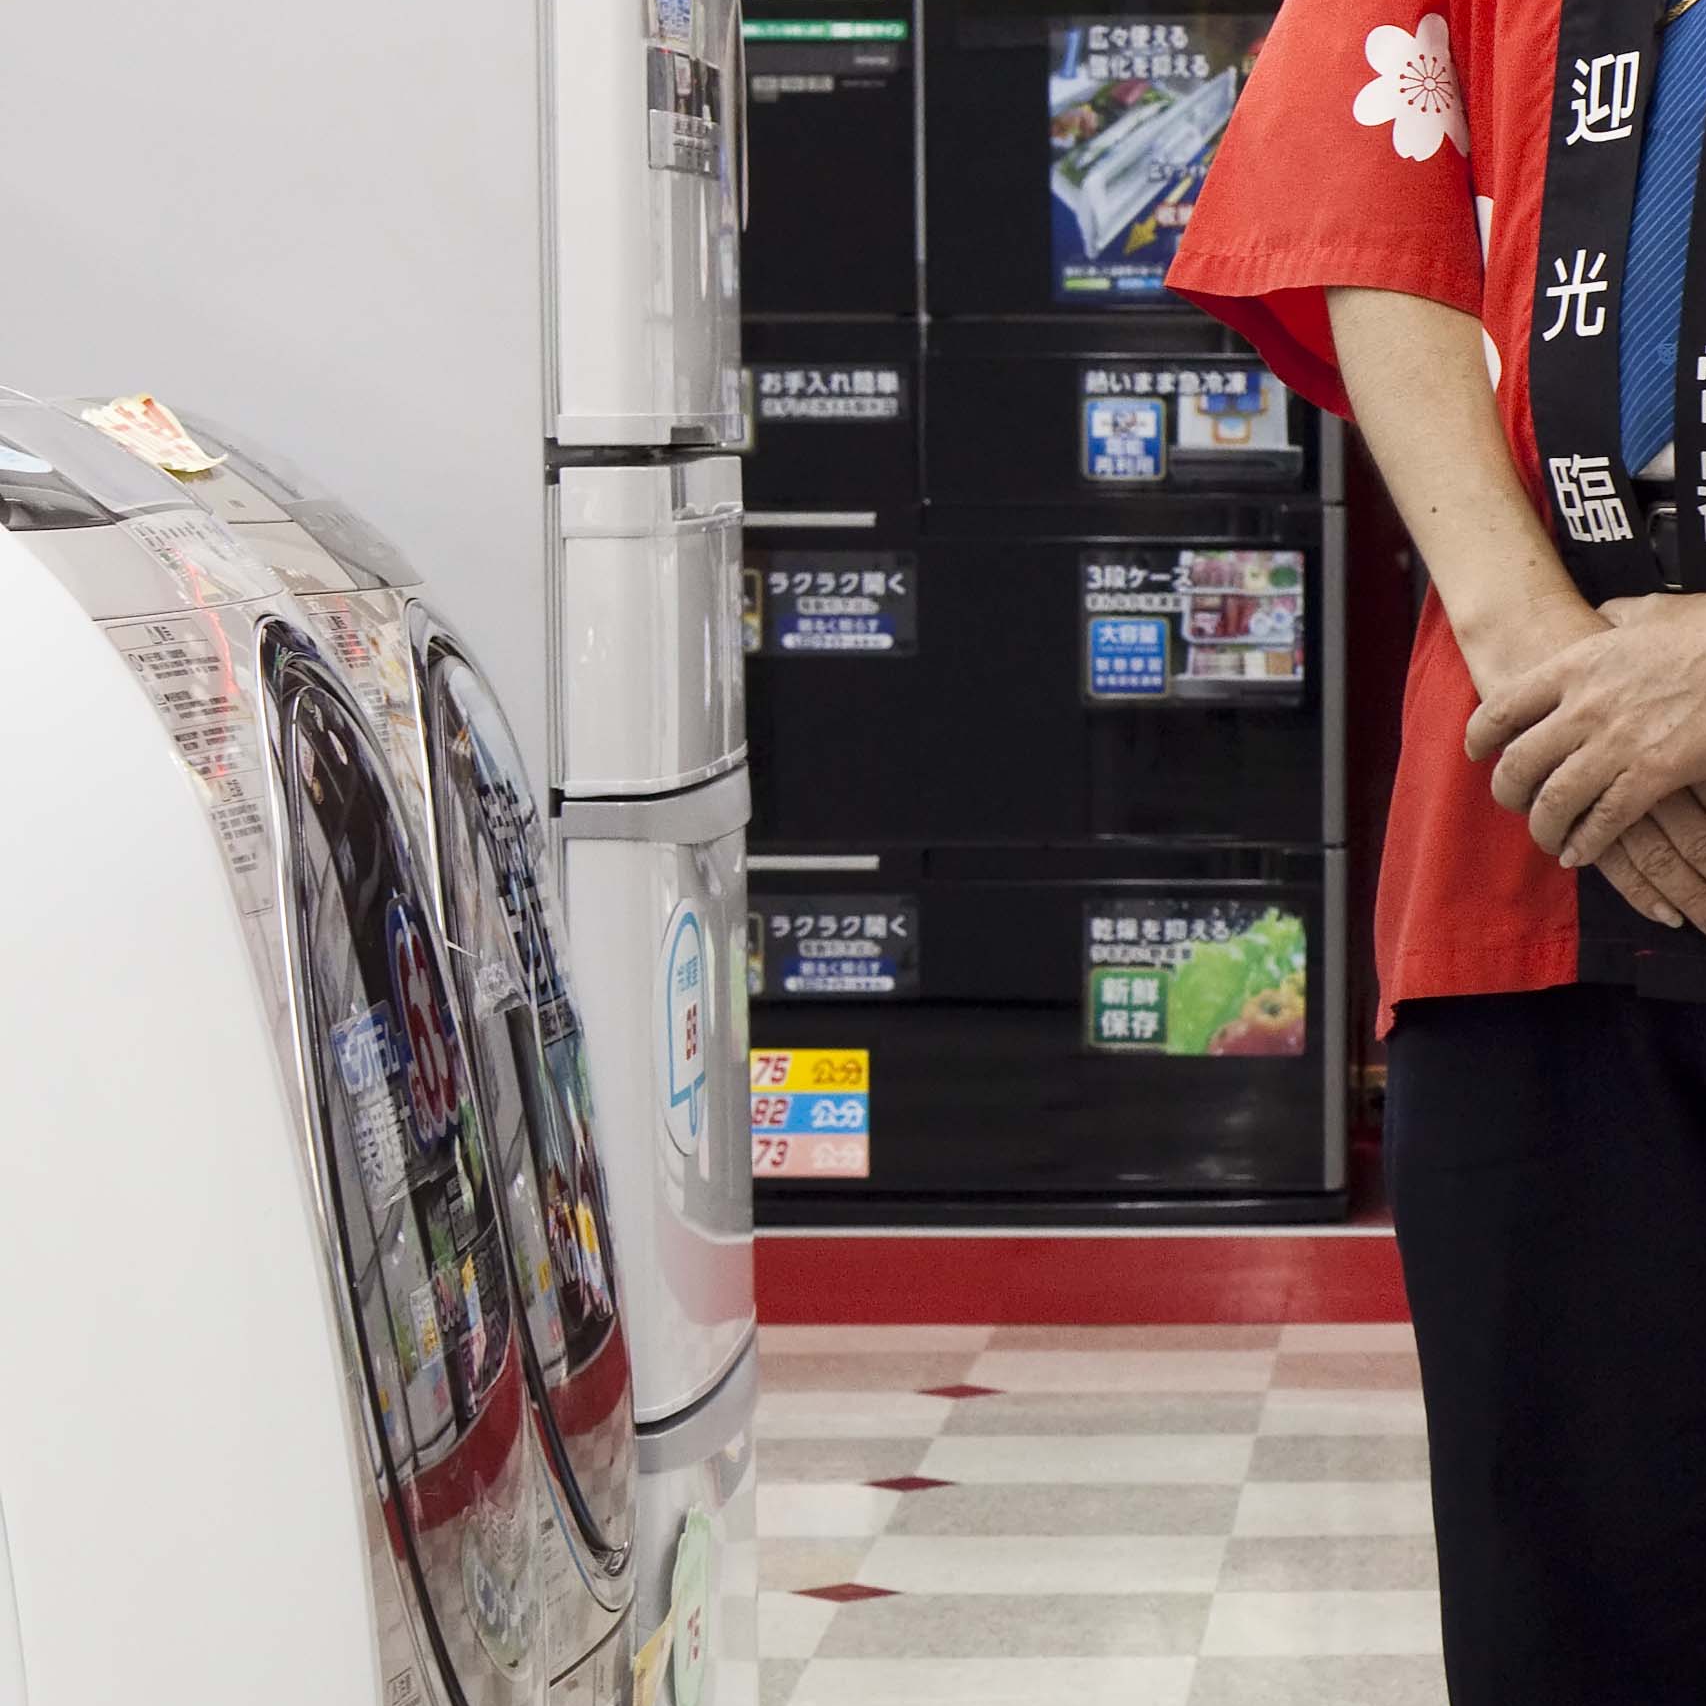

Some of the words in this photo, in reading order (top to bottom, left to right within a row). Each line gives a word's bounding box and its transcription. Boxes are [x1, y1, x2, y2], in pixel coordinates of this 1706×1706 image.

[761, 370, 899, 394] お手入れ簡単
[769, 571, 905, 596] ラクラク開く
[772, 914, 907, 939] ラクラク開く
[812, 1057, 863, 1085] 公分
[810, 1099, 864, 1128] 公分
